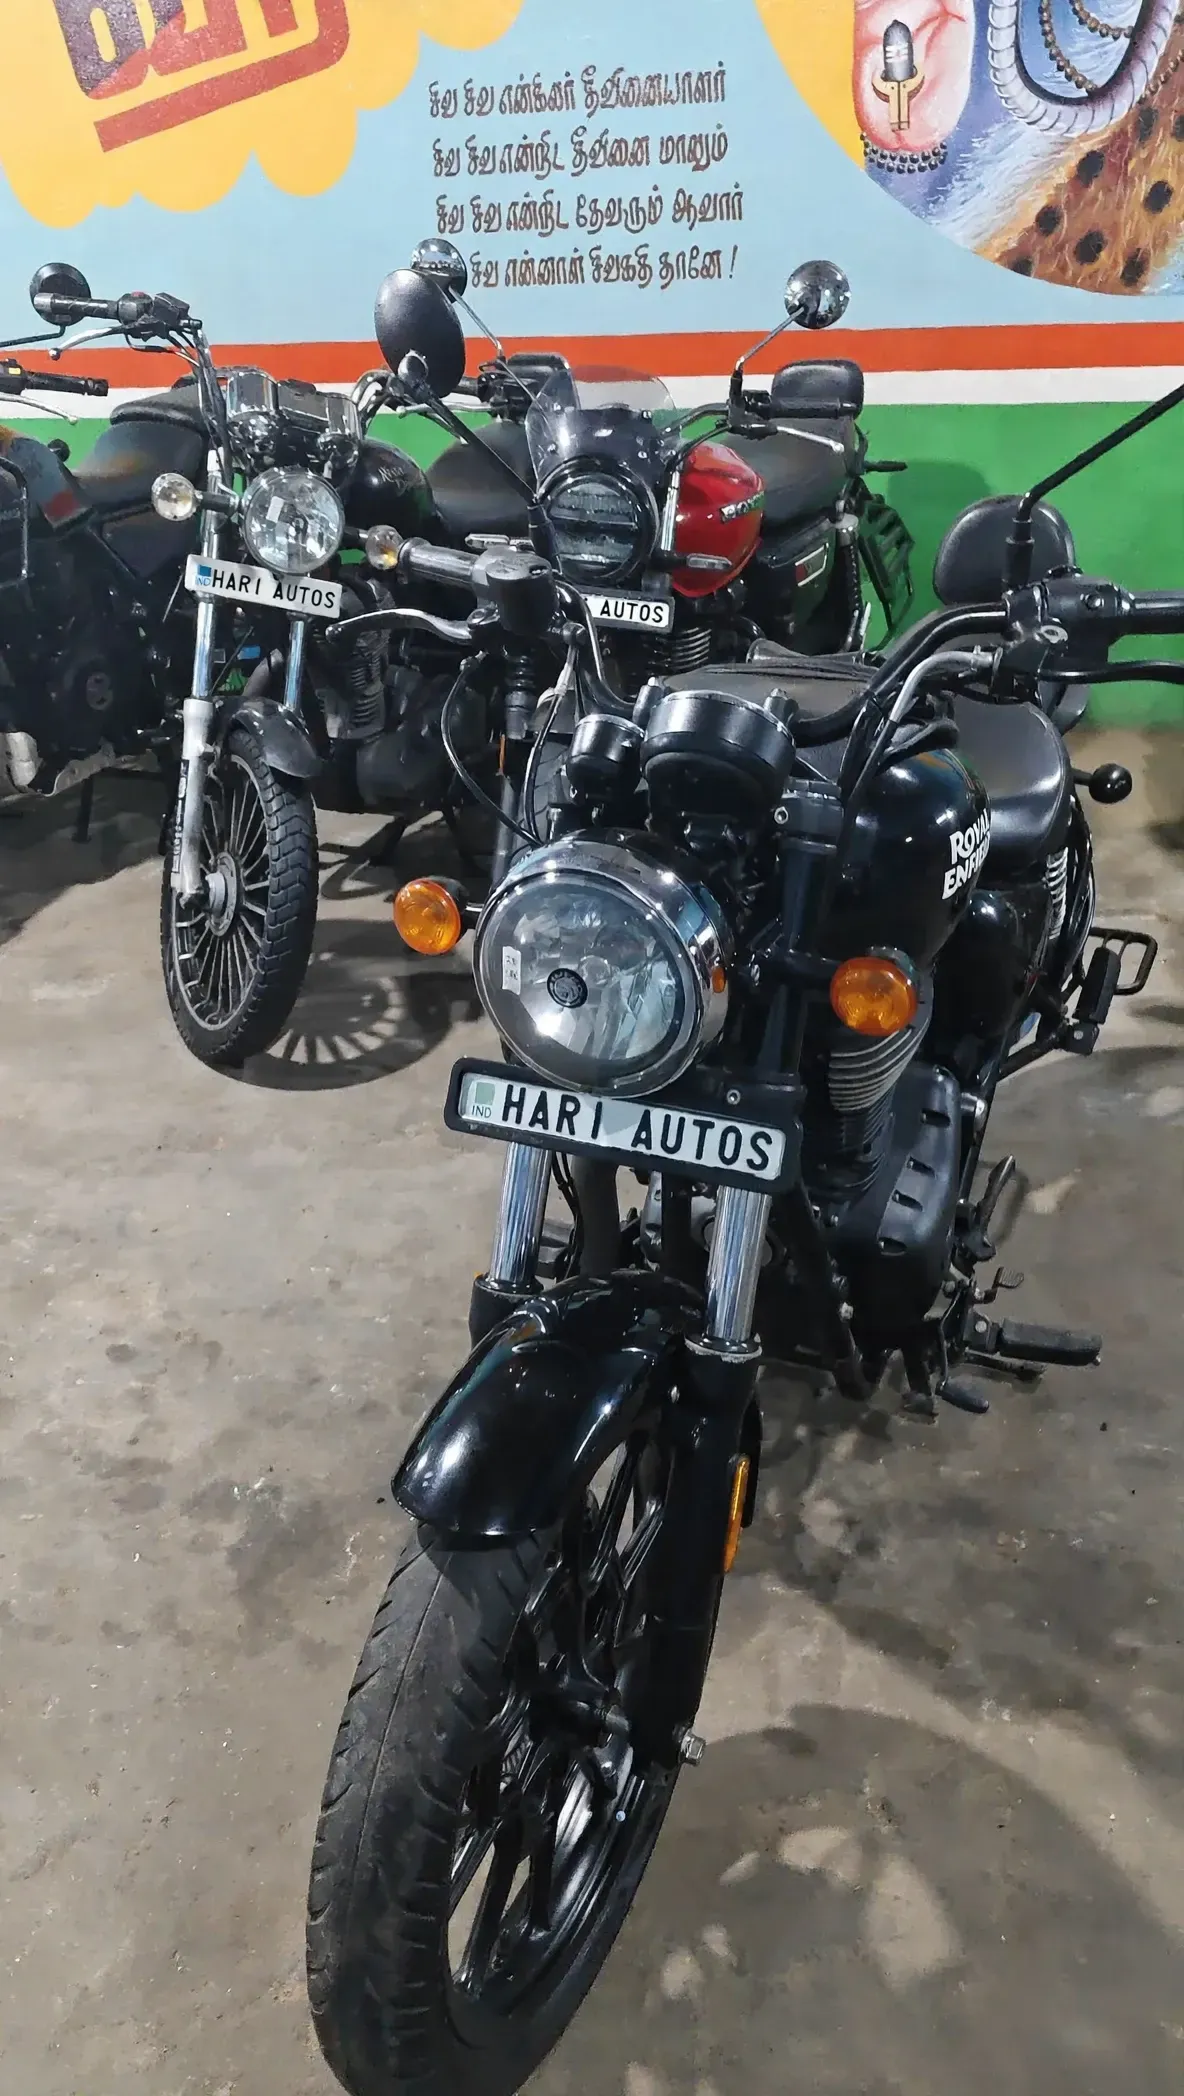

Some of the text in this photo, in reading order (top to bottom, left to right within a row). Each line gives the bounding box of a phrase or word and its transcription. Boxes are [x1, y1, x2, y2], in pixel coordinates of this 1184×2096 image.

[428, 80, 458, 119] சிவ
[463, 77, 495, 117] சிவ
[432, 137, 461, 178] சிவ
[464, 134, 497, 176] சிவ
[435, 193, 465, 235] சிவ
[469, 194, 503, 234] சிவ
[212, 569, 336, 609] HARI AUTOS
[600, 599, 664, 623] AUTOS
[949, 808, 990, 865] ROYAL
[471, 1104, 492, 1119] IND
[502, 1084, 774, 1172] HARI AUTOS
